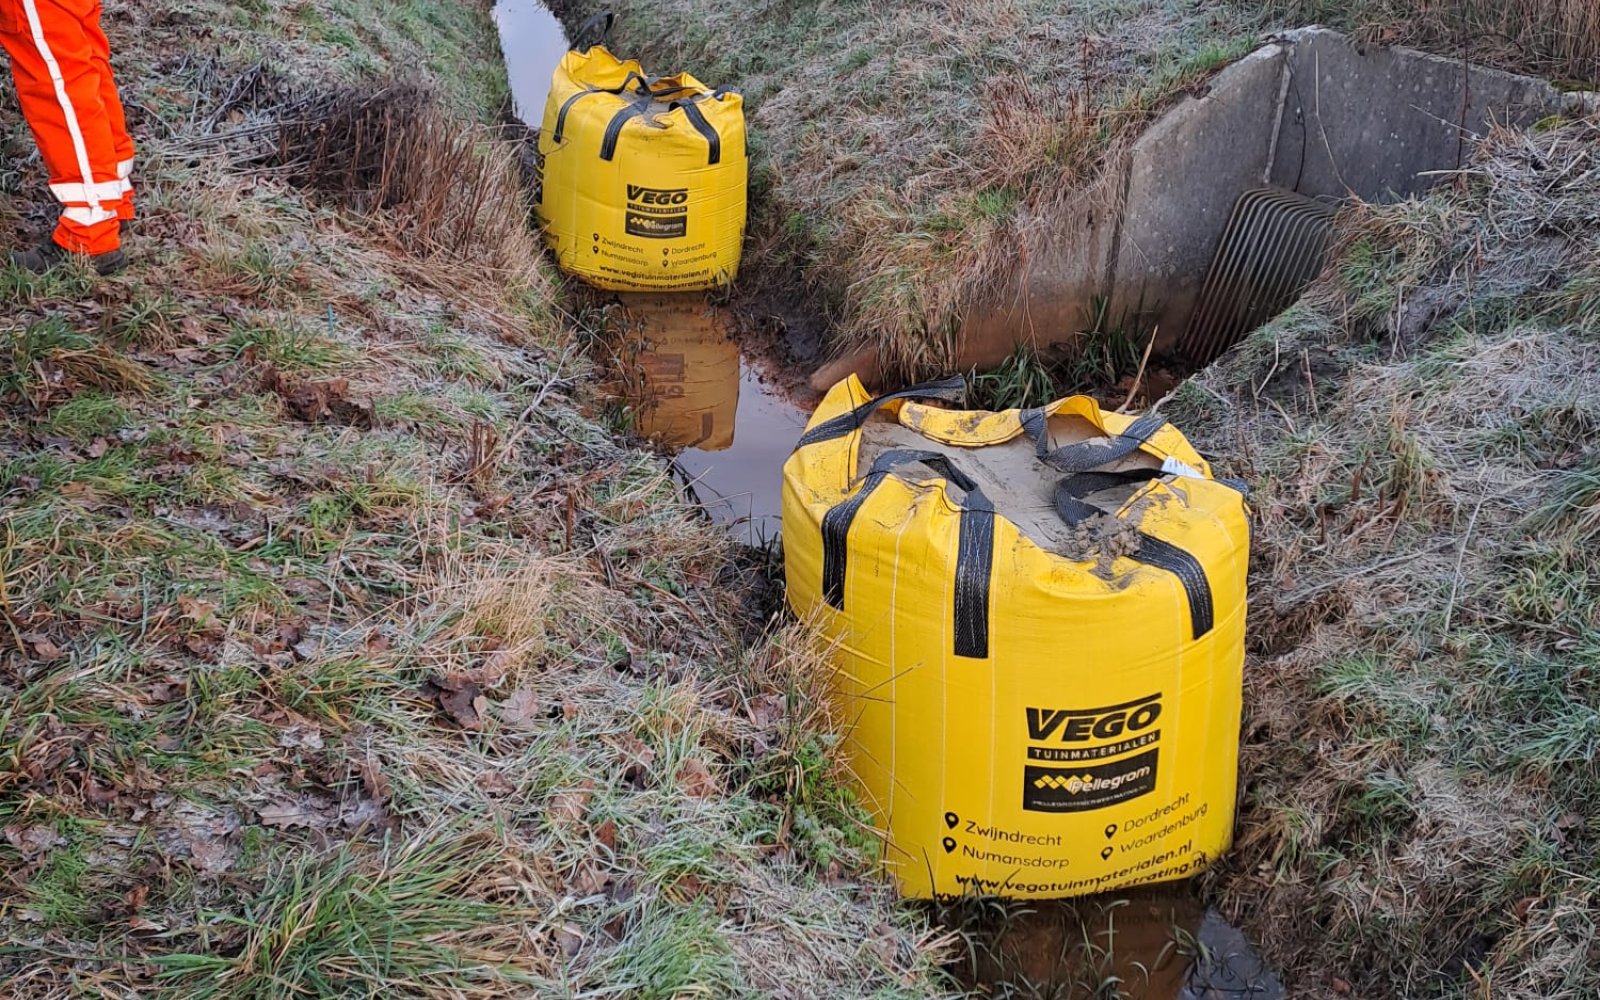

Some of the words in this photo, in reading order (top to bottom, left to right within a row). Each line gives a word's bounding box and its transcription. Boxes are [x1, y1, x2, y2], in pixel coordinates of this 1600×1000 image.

[627, 184, 688, 205] VEGO
[1025, 692, 1163, 741] VEGO
[1034, 732, 1157, 760] TUINMATERIALEN
[1067, 766, 1151, 794] Pellegrom
[1123, 792, 1190, 833] Dordrecht
[965, 820, 1063, 847] Zwijndrecht
[1120, 802, 1209, 853] Waardenburg
[962, 844, 1070, 869] Numansdorp
